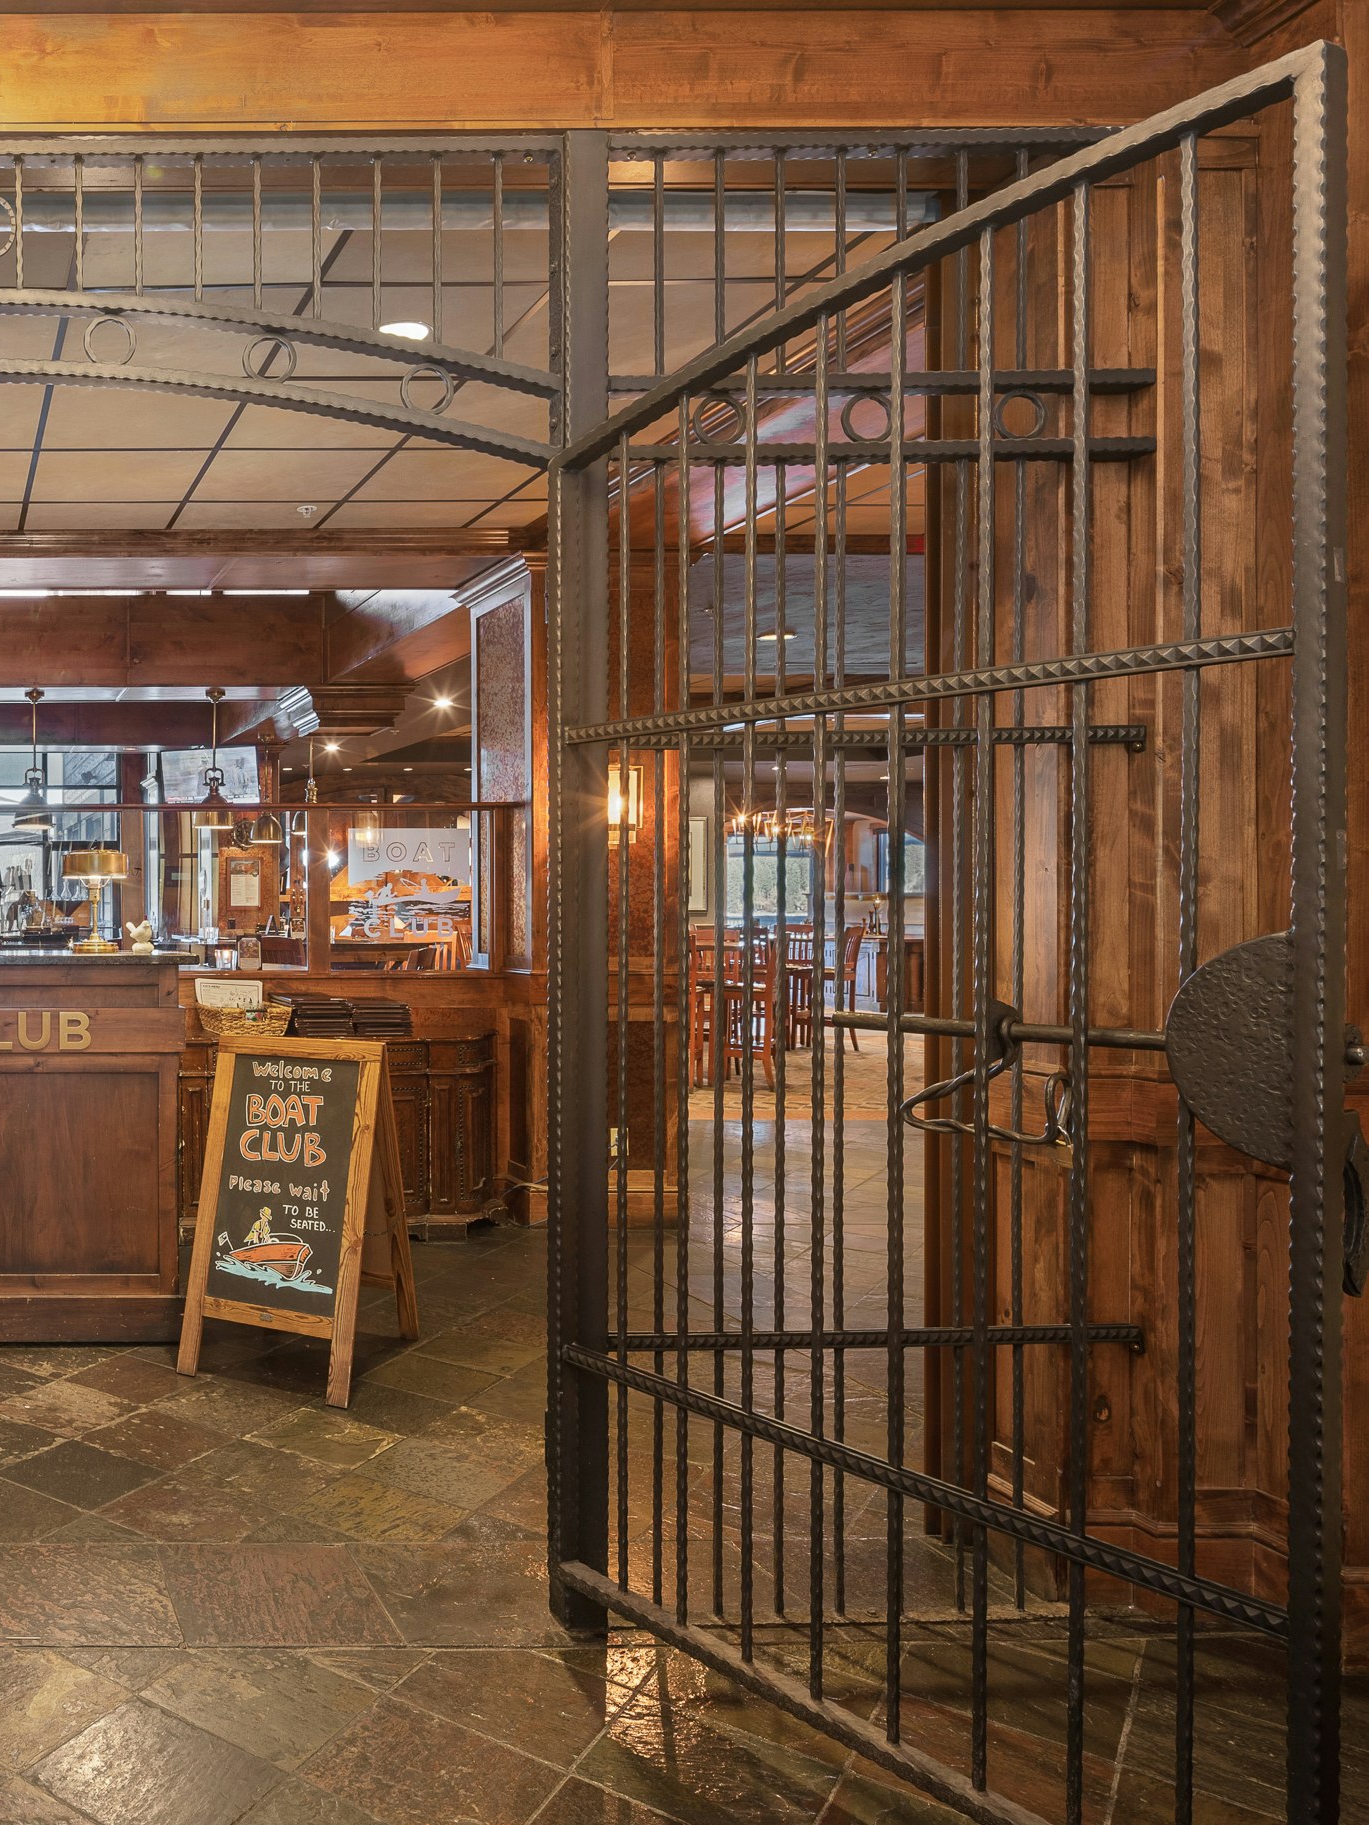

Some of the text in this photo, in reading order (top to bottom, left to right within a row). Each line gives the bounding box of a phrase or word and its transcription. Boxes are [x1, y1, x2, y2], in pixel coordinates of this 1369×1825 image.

[362, 841, 456, 863] BOAT
[363, 917, 454, 938] CLUB
[252, 1060, 333, 1083] Welcome
[269, 1080, 311, 1093] TO THE
[245, 1093, 325, 1129] BOAT
[239, 1128, 327, 1168] CLUB
[229, 1174, 331, 1202] Please wait
[282, 1204, 319, 1219] TO BE
